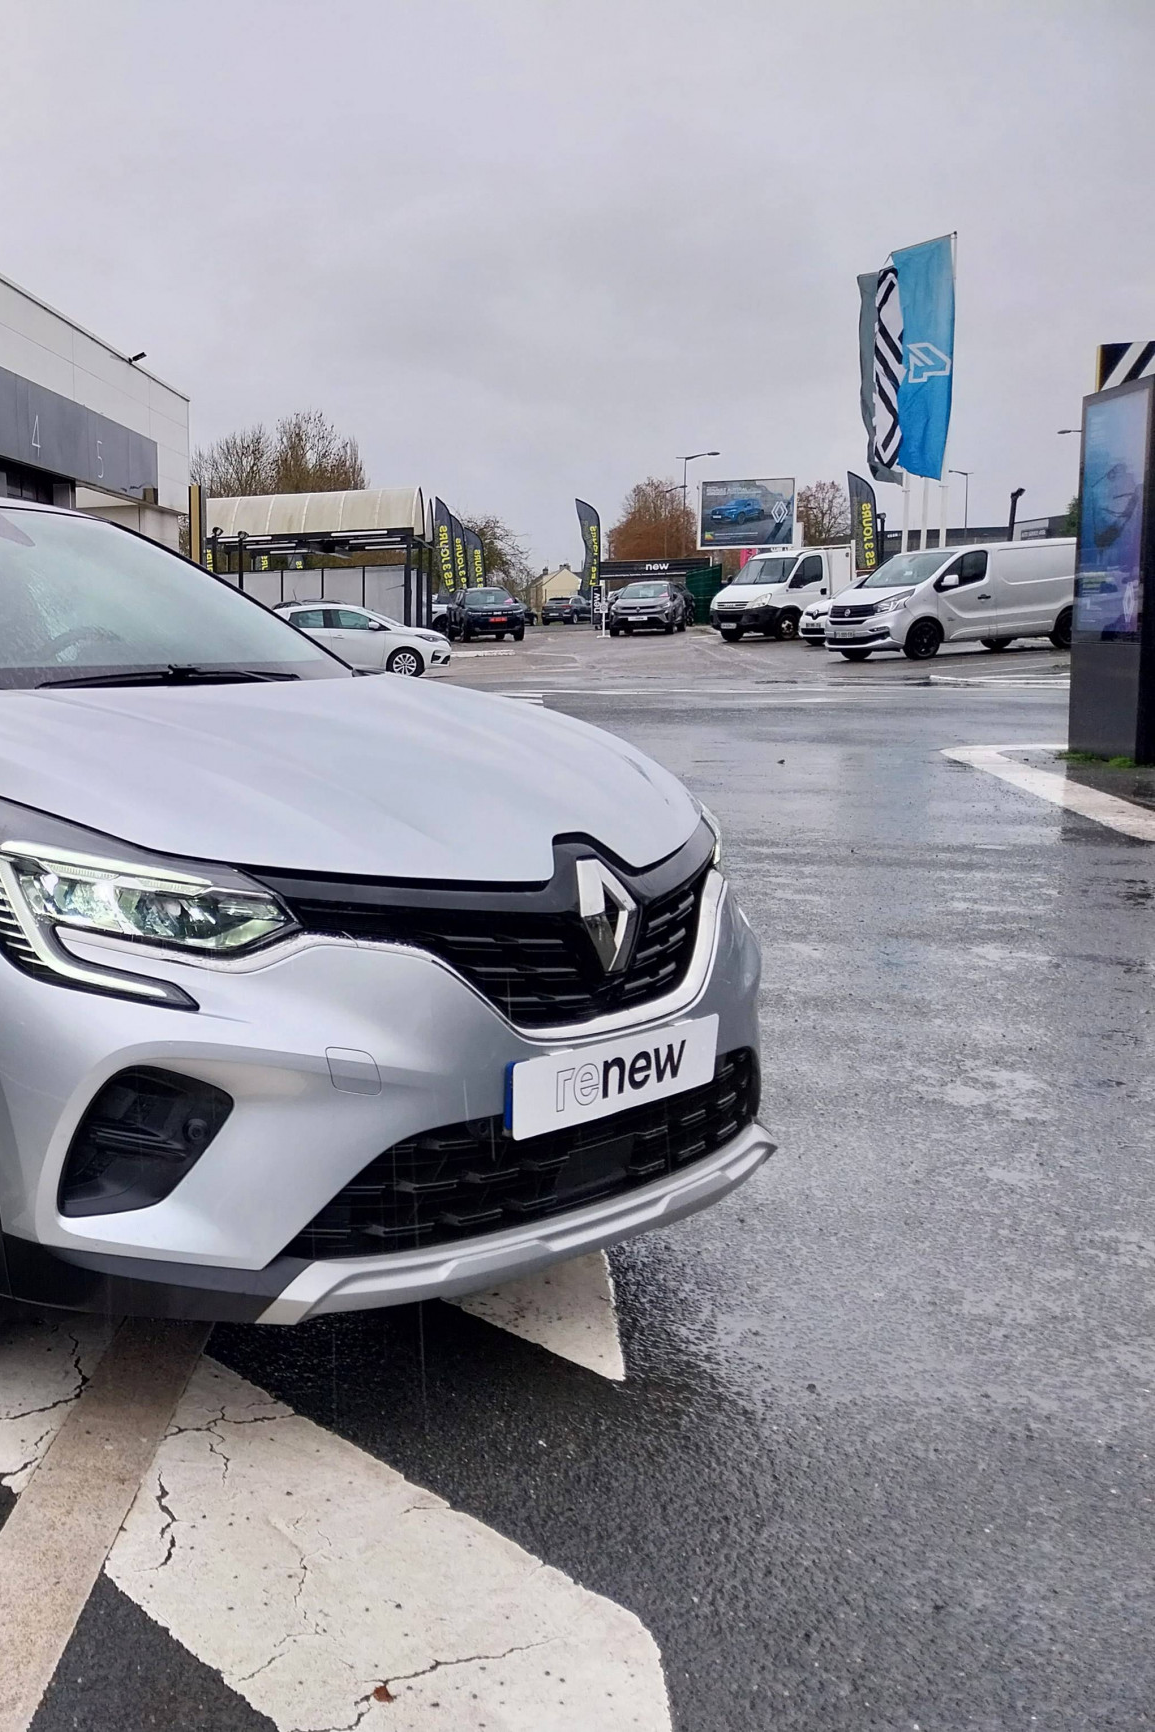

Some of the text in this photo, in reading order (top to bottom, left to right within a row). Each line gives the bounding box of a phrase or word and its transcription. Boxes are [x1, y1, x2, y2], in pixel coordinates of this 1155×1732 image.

[31, 414, 41, 458] 4
[96, 440, 104, 479] 5
[555, 1039, 687, 1113] renew
